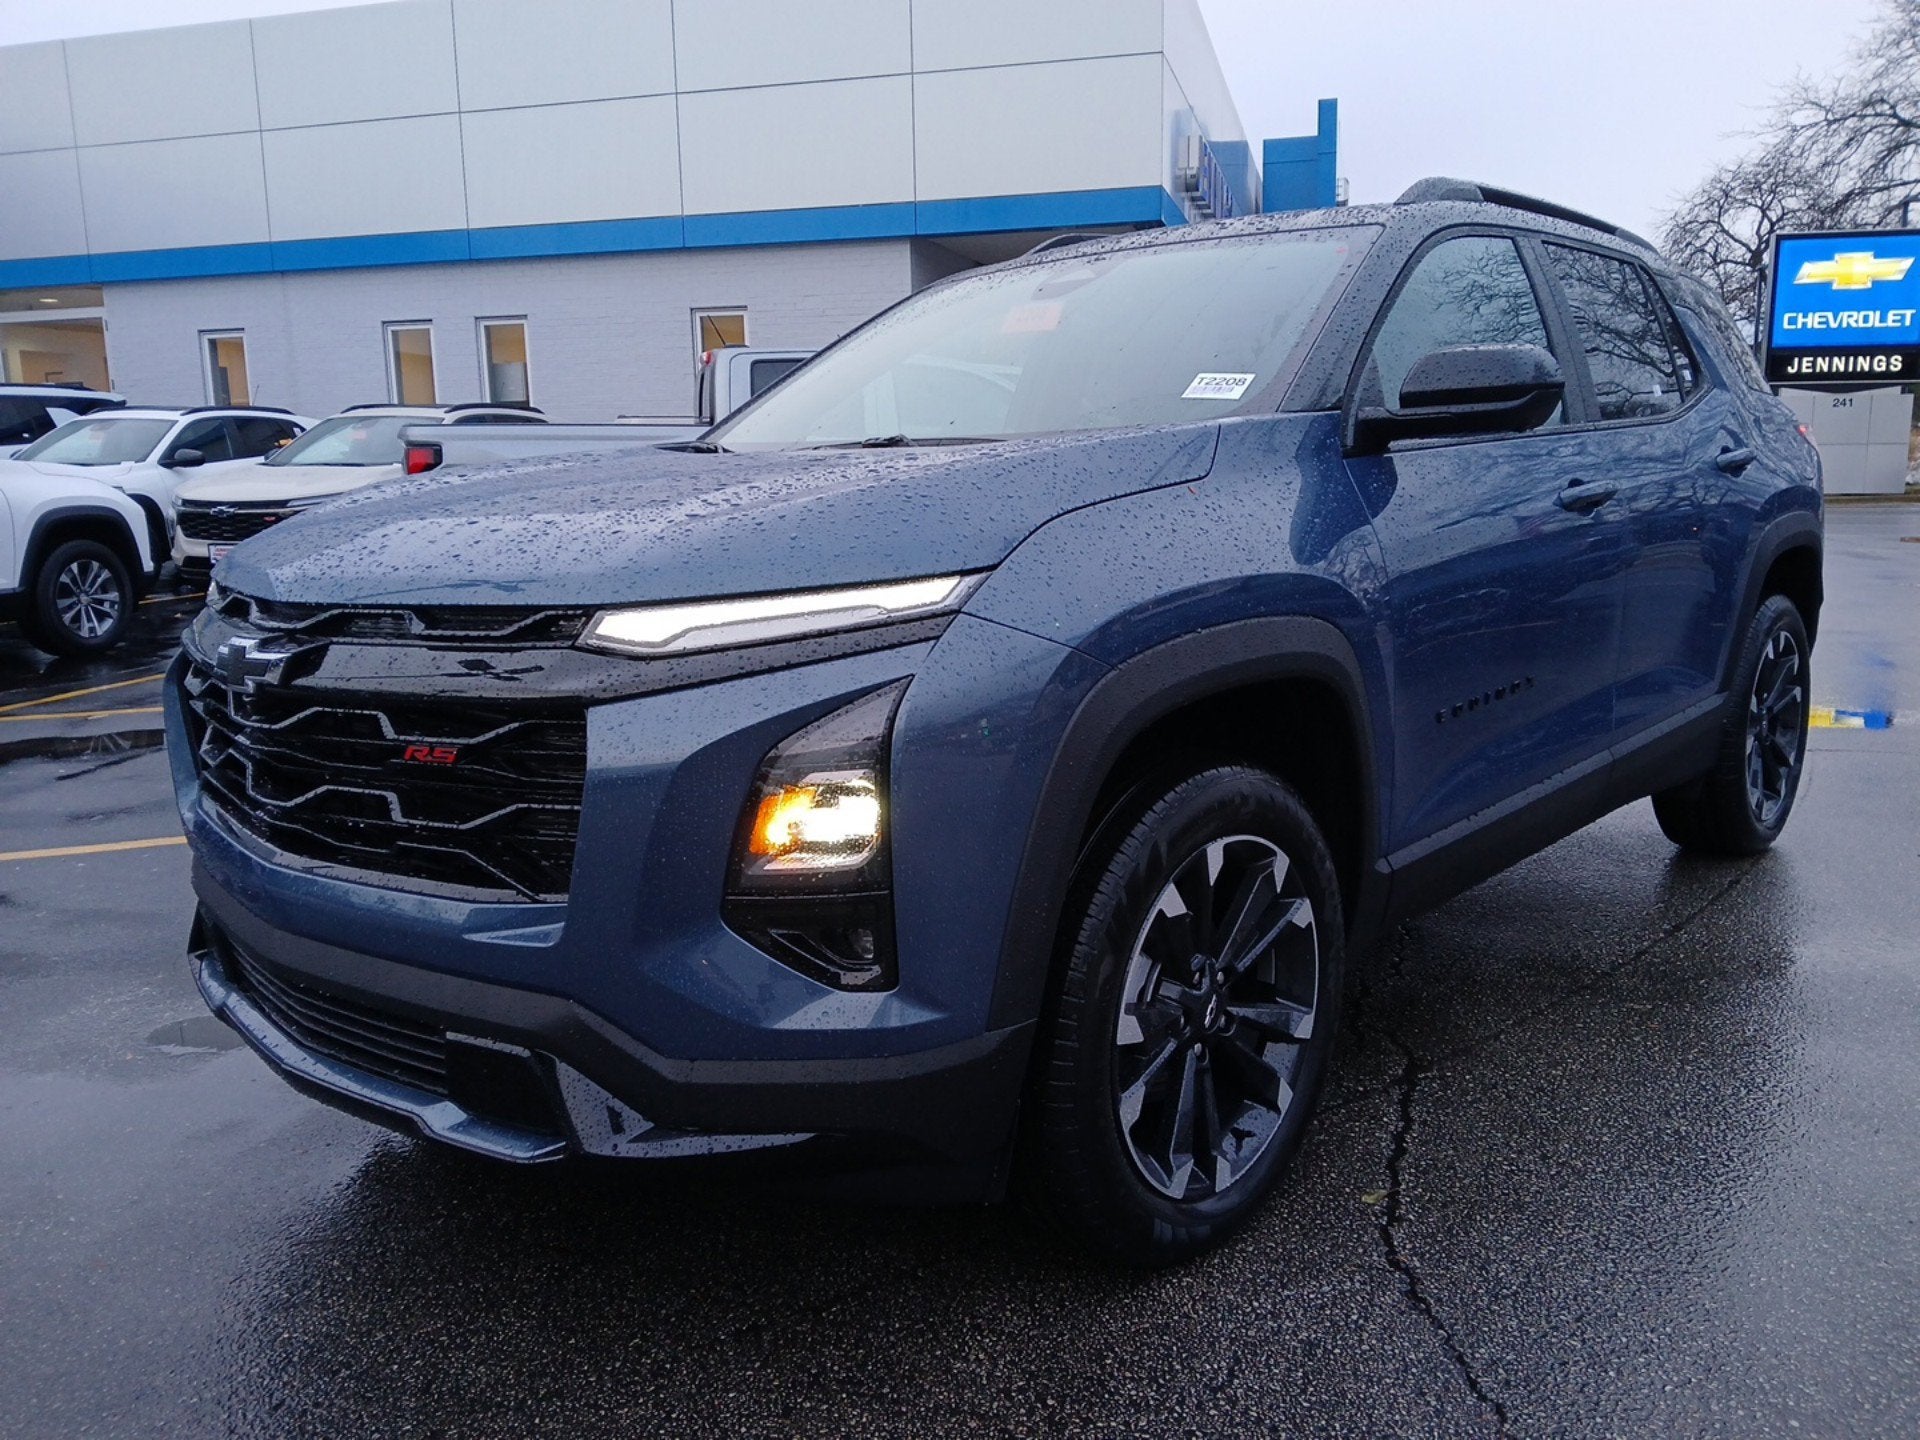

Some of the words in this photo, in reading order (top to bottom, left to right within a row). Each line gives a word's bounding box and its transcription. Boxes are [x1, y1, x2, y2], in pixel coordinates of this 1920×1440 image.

[1783, 309, 1917, 330] CHEVROLET
[1787, 355, 1903, 373] JENNINGS
[1197, 376, 1247, 386] T2208
[1832, 398, 1853, 408] 241
[404, 745, 458, 763] RS
